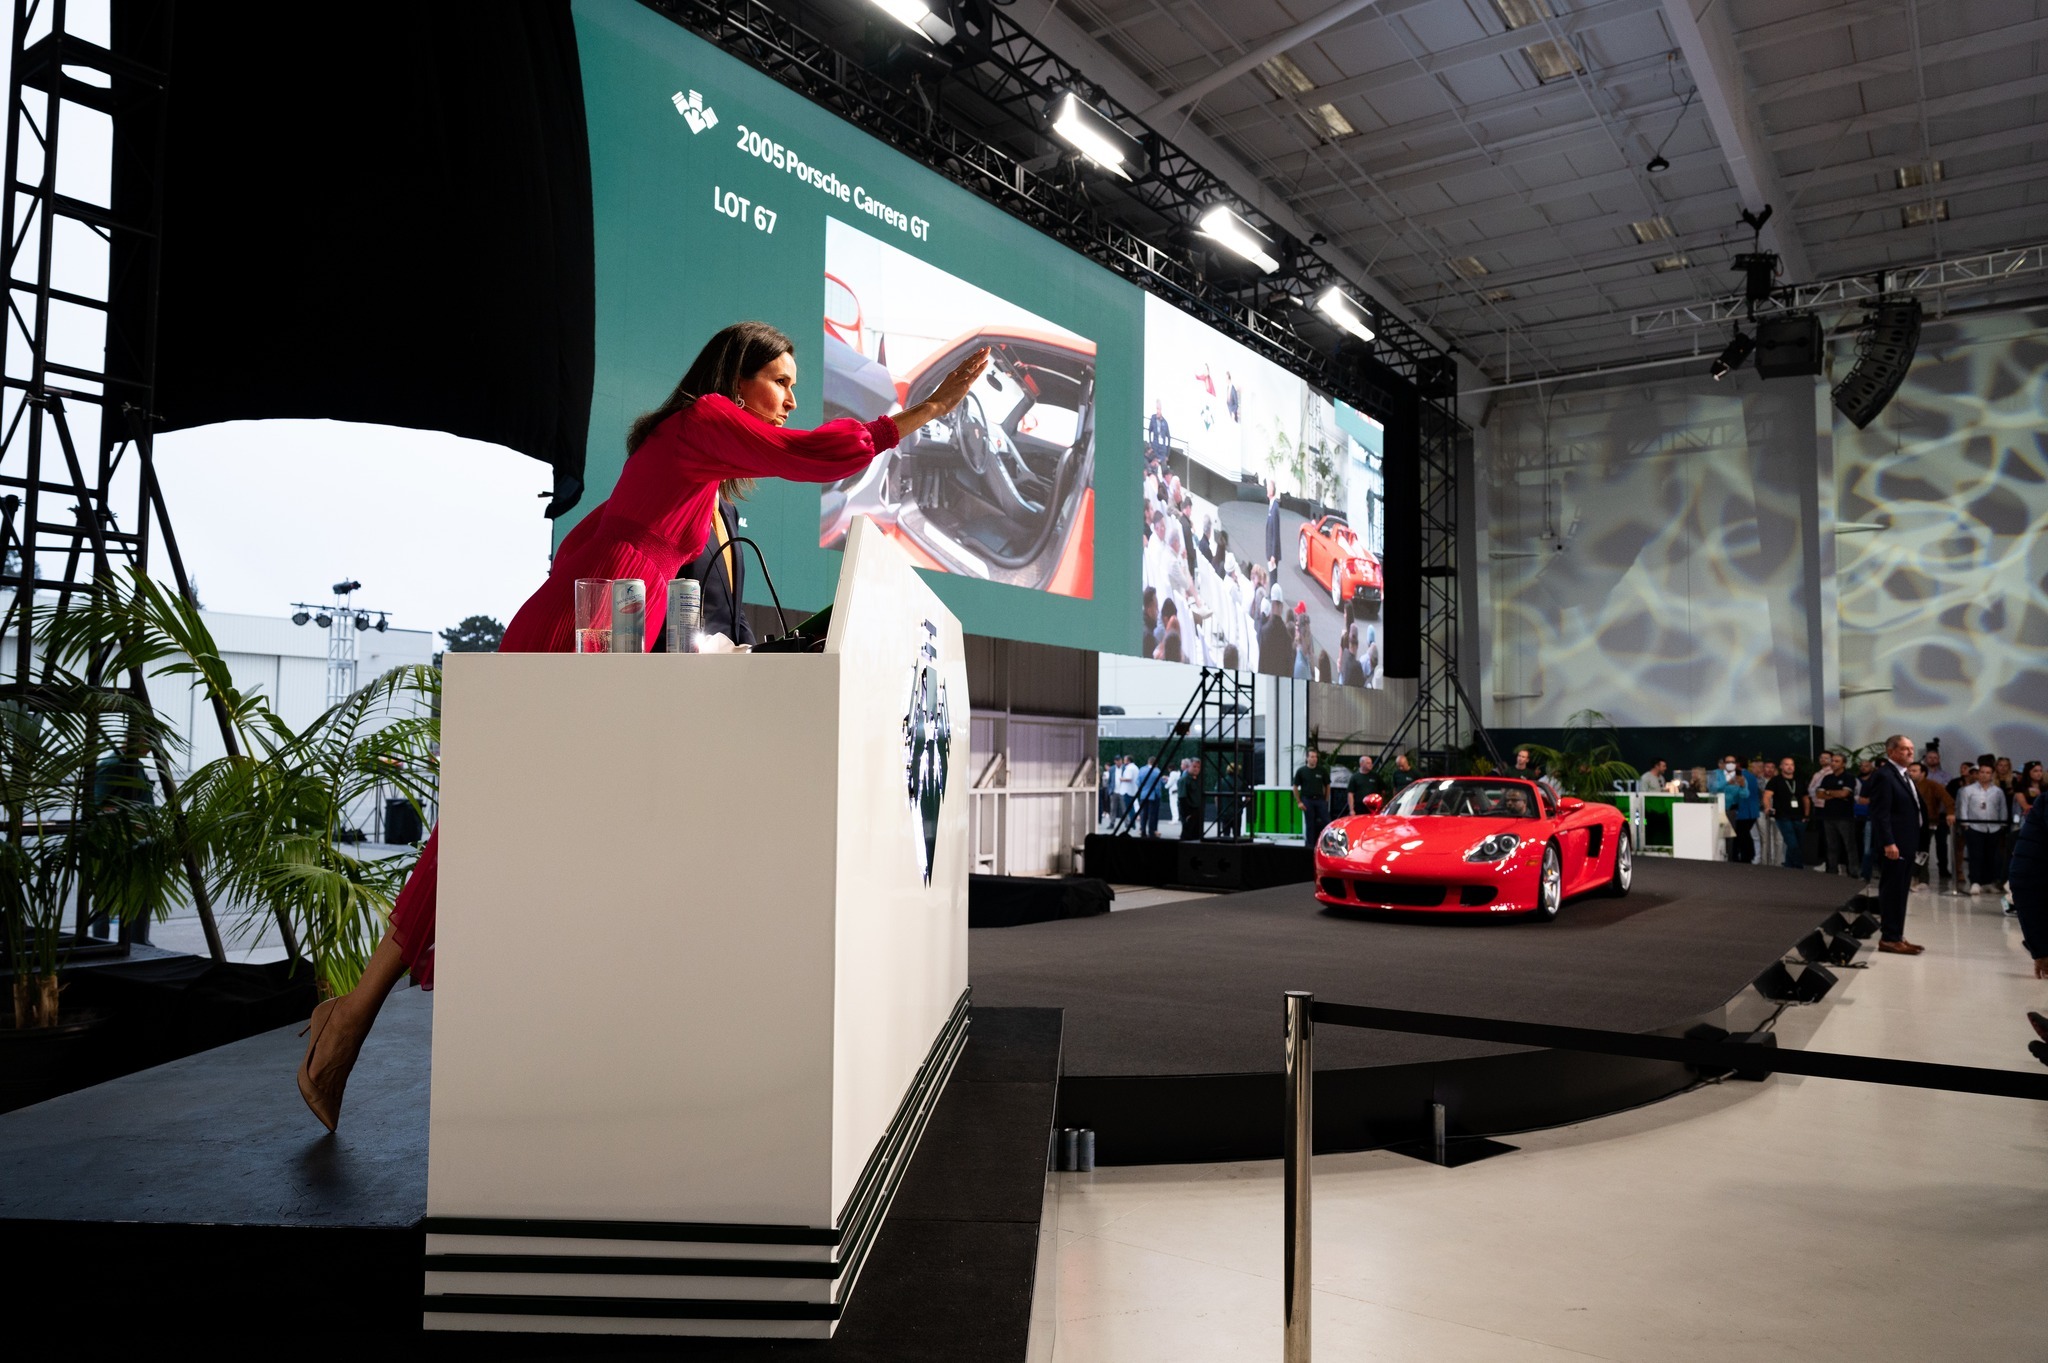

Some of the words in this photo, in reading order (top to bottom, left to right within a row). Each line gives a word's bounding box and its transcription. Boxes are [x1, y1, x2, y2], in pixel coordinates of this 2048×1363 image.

[714, 186, 751, 223] LOT
[754, 205, 778, 234] 67
[736, 125, 785, 169] 2005
[786, 149, 850, 203] Porsche
[853, 186, 908, 232] Carrera
[910, 215, 930, 242] GT
